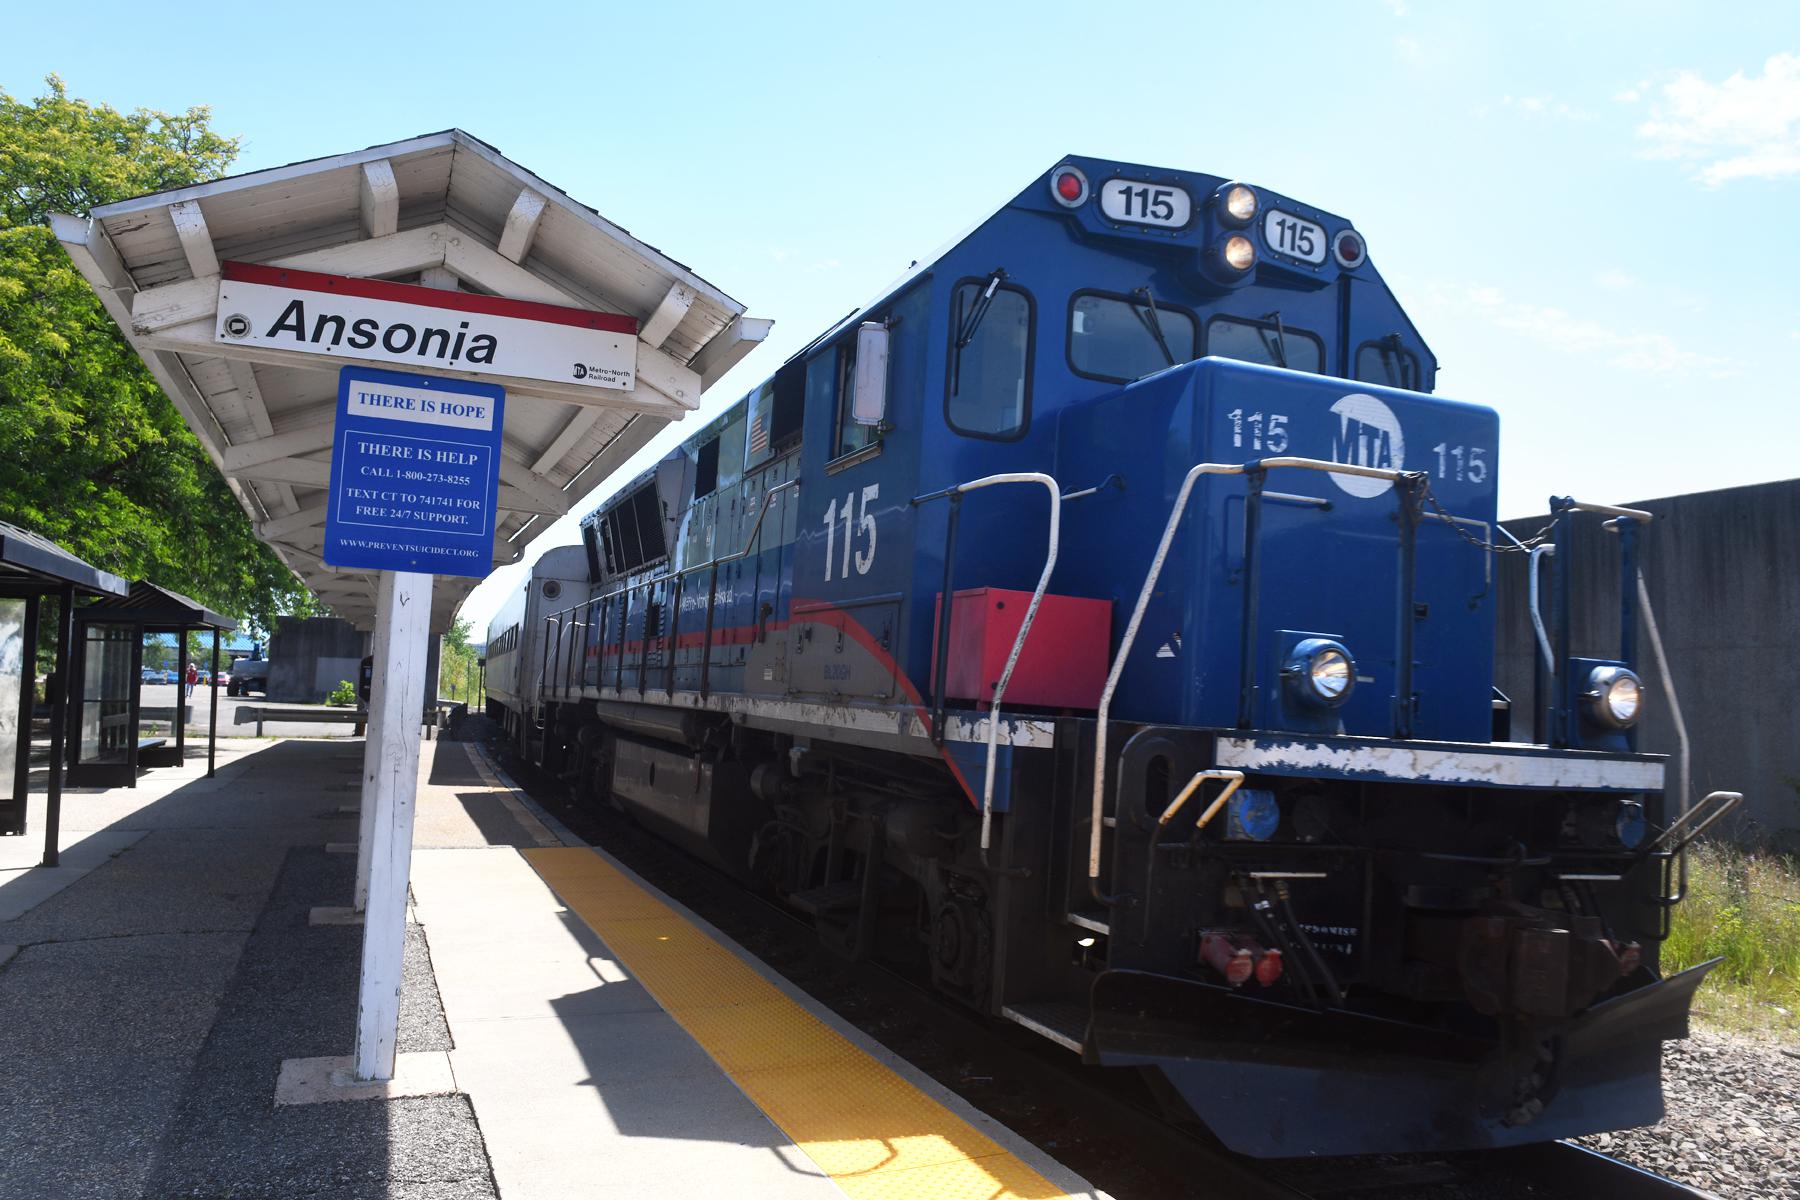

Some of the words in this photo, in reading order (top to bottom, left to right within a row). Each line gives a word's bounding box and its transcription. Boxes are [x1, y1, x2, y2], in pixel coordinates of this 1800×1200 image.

[1117, 185, 1174, 221] 115
[1275, 218, 1315, 257] 115
[265, 299, 498, 365] Ansonia
[588, 373, 616, 382] Railroad
[589, 366, 630, 377] Metro-North
[358, 391, 416, 411] THERE
[421, 400, 435, 413] IS
[440, 402, 486, 419] HOPE
[1227, 408, 1288, 453] 115
[357, 441, 413, 459] THERE
[418, 448, 432, 461] IS
[436, 450, 478, 466] HELP
[1432, 442, 1487, 483] 115
[360, 465, 393, 479] CALL
[396, 470, 470, 485] 1-800-273-8255
[346, 487, 379, 501] TEXT
[381, 491, 399, 502] CT
[400, 493, 417, 504] TO
[420, 495, 453, 507] 741741
[456, 498, 481, 510] FOR
[355, 505, 388, 518] FREE
[390, 508, 412, 520] 24/7
[413, 511, 469, 525] SUPPORT.
[823, 483, 880, 582] 115
[340, 538, 479, 557] WWW.PREVENTSUICIDECT.ORG
